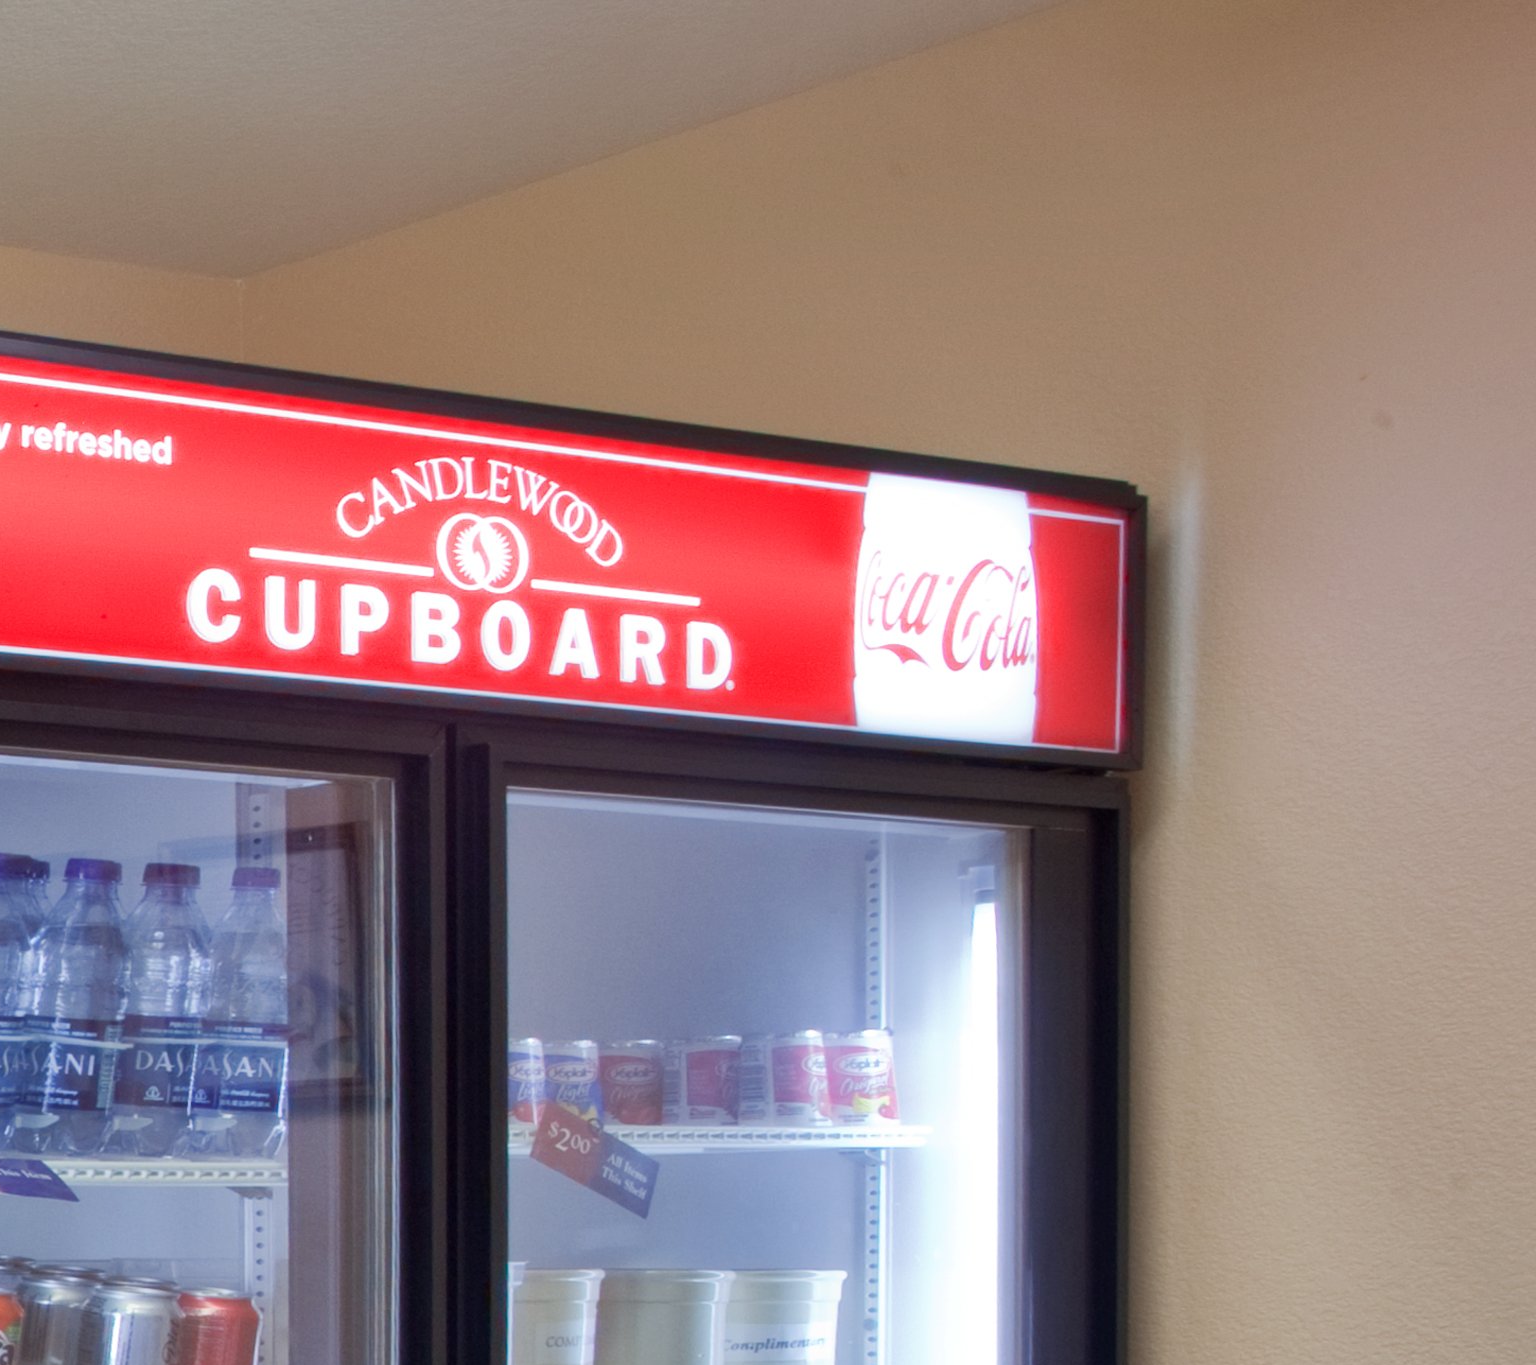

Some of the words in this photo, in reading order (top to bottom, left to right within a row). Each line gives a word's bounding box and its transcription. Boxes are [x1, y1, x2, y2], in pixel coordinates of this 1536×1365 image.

[20, 422, 172, 465] refreshed
[336, 456, 624, 569] CANDLEWOOD
[186, 568, 732, 690] CUPBOARD
[550, 1064, 594, 1082] Yoplait
[610, 1064, 654, 1081] Yoplait
[843, 1055, 886, 1073] Yoplait
[601, 1167, 623, 1185] This
[624, 1177, 646, 1200] Shelf
[607, 1153, 624, 1169] All
[624, 1161, 648, 1183] Items
